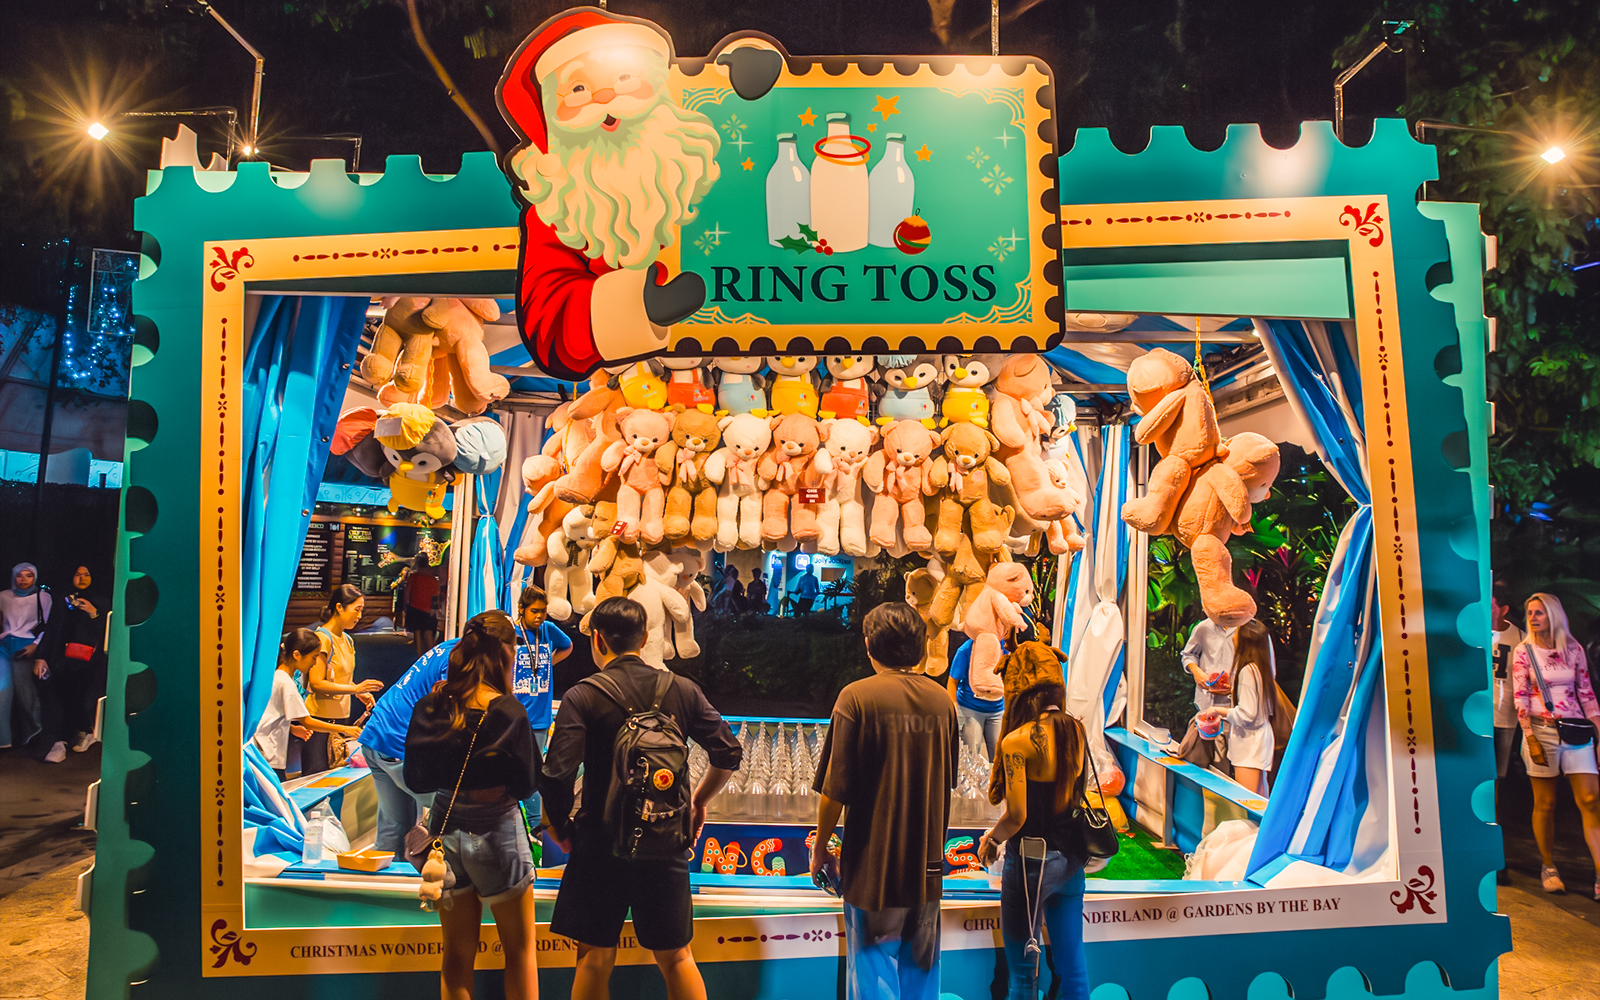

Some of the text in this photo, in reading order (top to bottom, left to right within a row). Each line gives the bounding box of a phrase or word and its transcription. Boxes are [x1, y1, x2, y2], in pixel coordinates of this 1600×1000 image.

[710, 264, 997, 303] RING TOSS
[1083, 898, 1341, 924] NDERLAND @ GARDENS BY THE BAY
[290, 944, 377, 958] CHRISTMAS
[618, 936, 637, 949] HE
